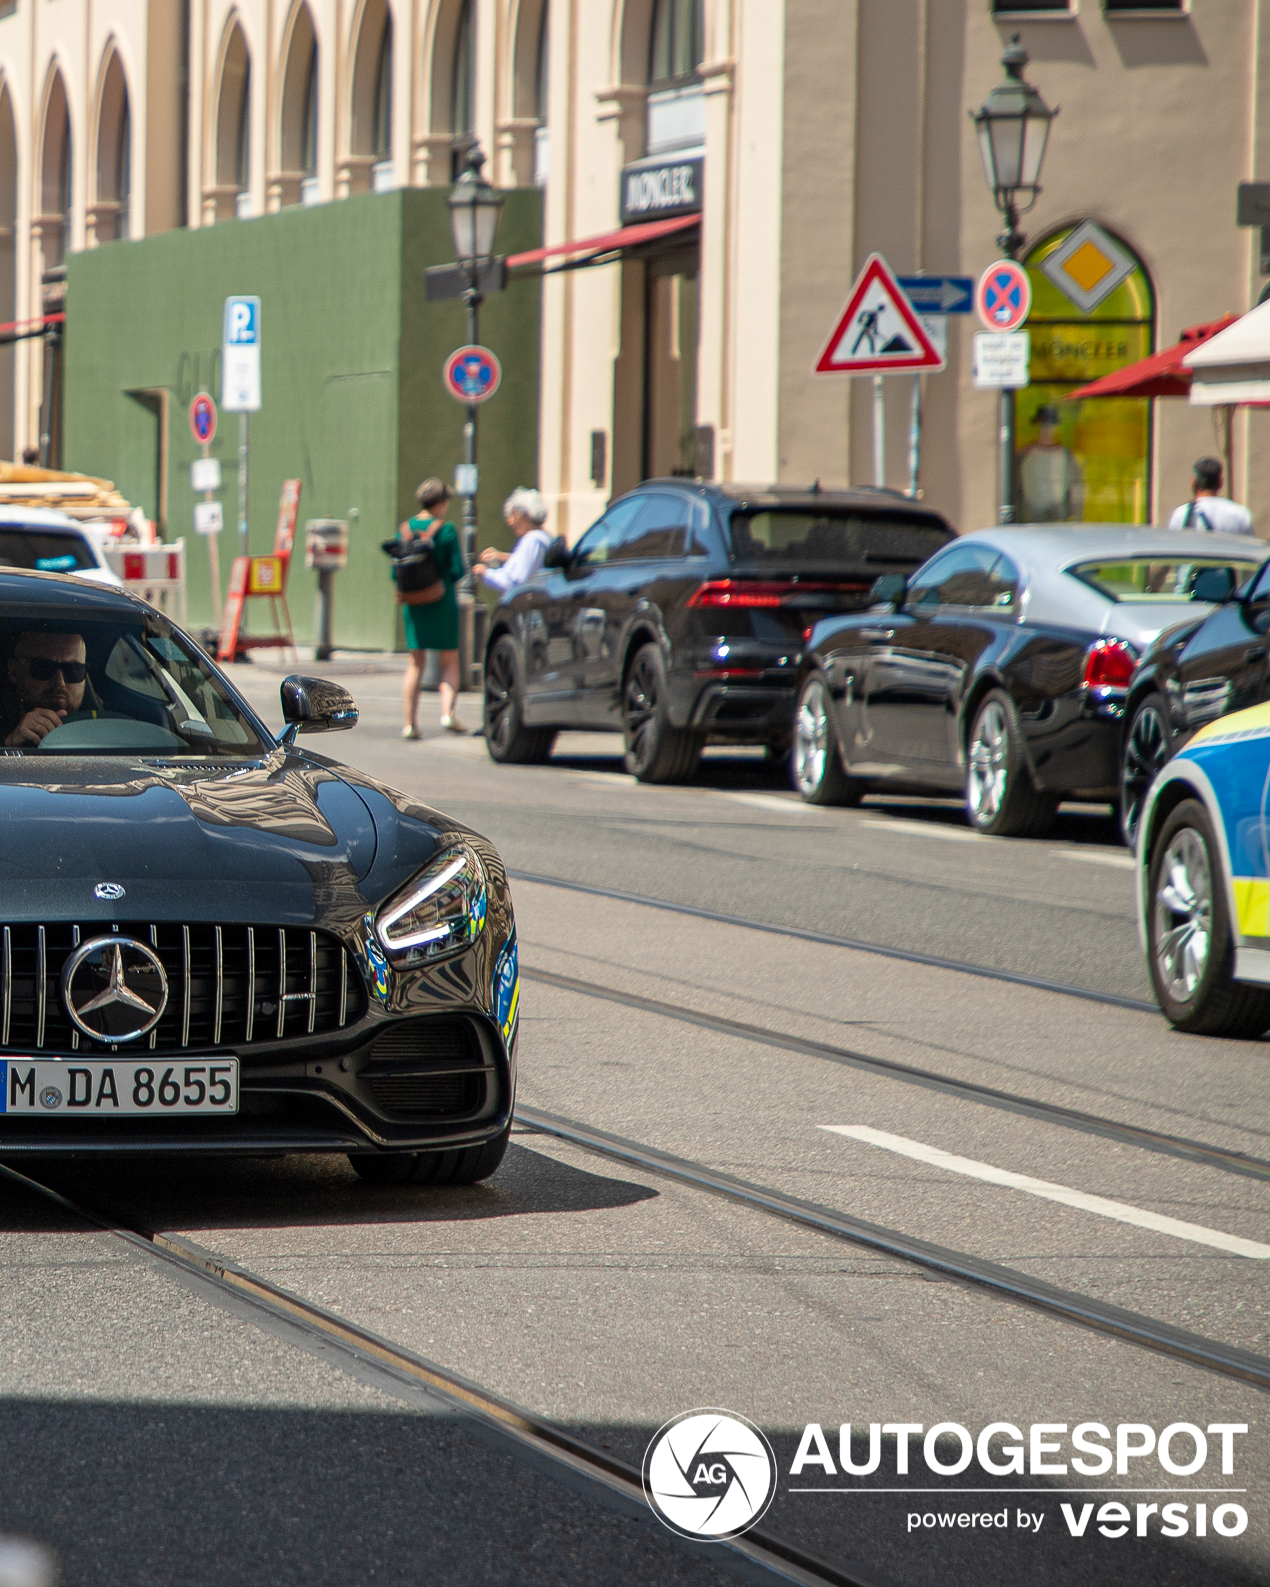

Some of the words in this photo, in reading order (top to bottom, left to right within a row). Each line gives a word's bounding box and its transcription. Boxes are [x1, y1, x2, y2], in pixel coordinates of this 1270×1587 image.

[626, 165, 694, 211] MONCLER
[232, 303, 251, 342] P
[11, 1067, 35, 1106] M
[67, 1067, 119, 1107] DA
[133, 1067, 231, 1106] 8655
